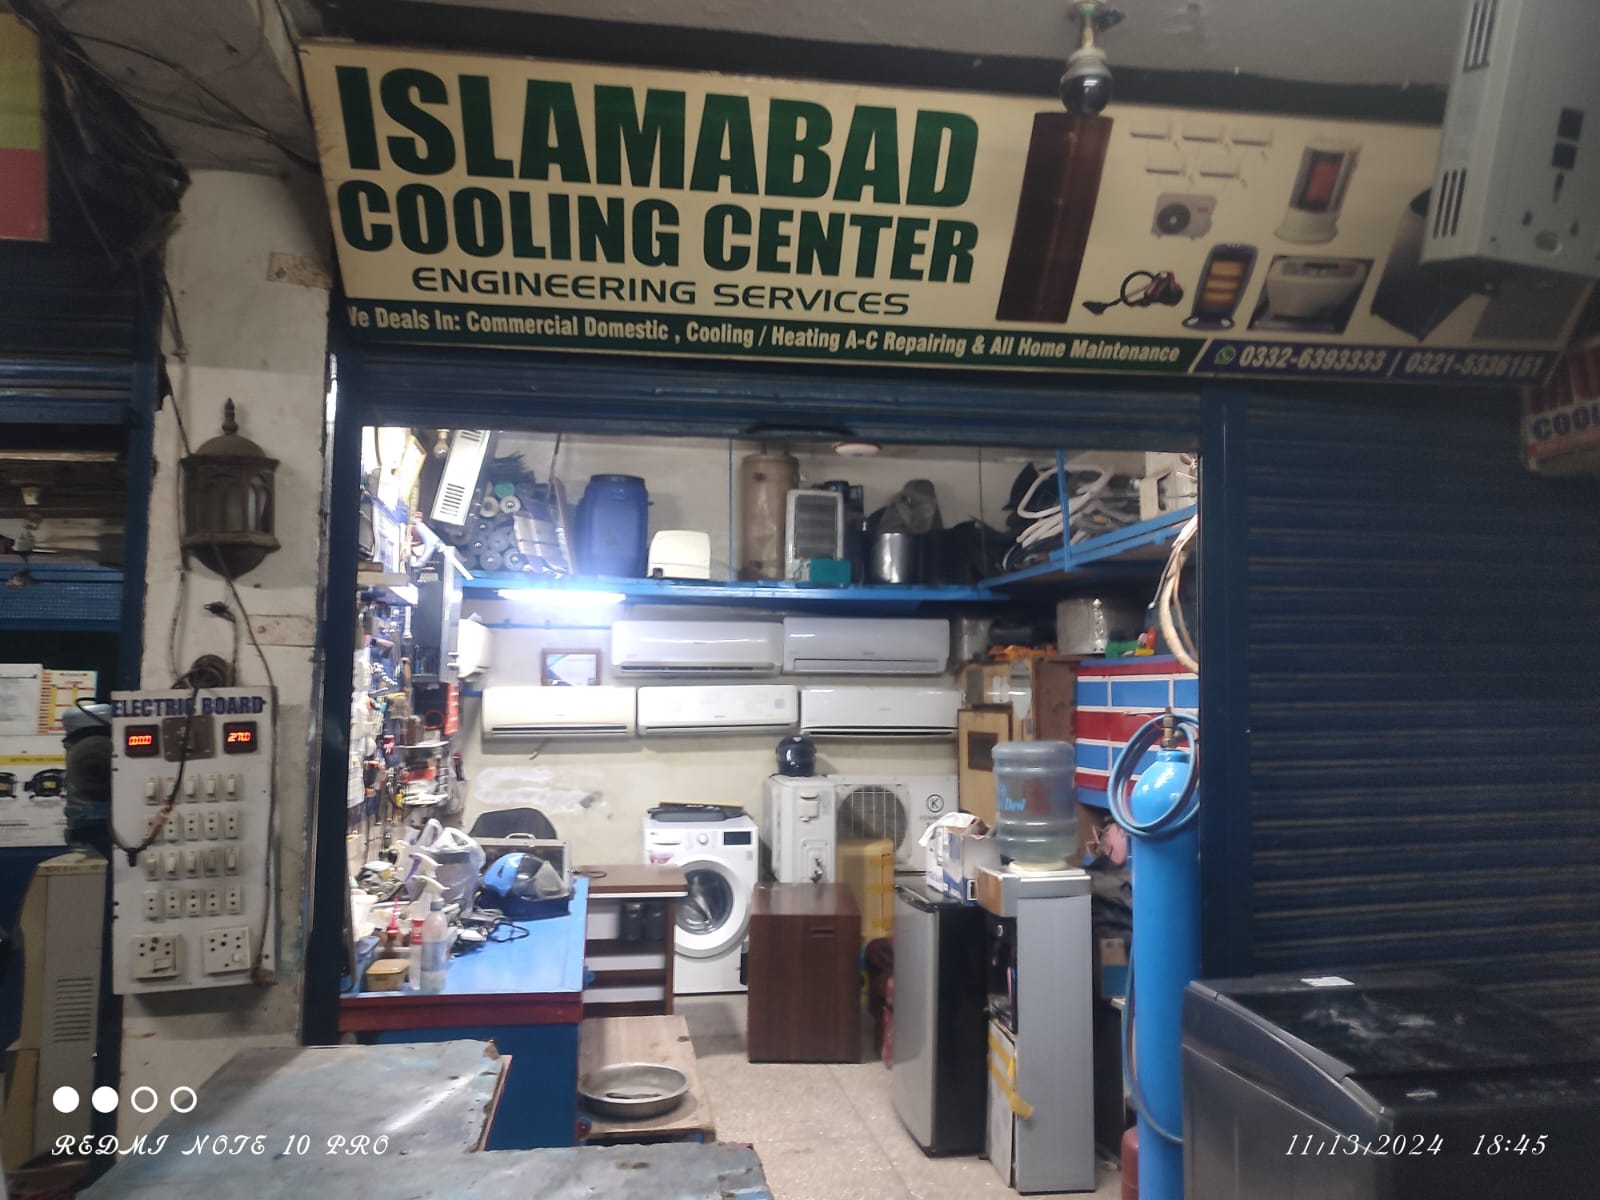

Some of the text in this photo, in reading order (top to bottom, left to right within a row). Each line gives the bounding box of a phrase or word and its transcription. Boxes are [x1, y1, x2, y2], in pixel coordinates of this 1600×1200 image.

[335, 65, 979, 208] ISLAMABAD
[337, 179, 979, 284] COOLING CENTER
[412, 267, 910, 316] ENGINEERING SERVICES
[375, 306, 430, 331] Deals
[434, 309, 461, 331] In:
[466, 310, 578, 337] Commercial
[584, 315, 669, 341] Domestic
[686, 320, 754, 348] Cooling
[771, 325, 841, 352] Heating
[845, 329, 878, 350] A-C
[883, 331, 967, 358] Repairing
[971, 335, 984, 355] &
[990, 335, 1015, 357] All
[1017, 336, 1066, 359] Home
[1070, 339, 1180, 363] Maintenance
[1240, 345, 1387, 372] 0332-6393333
[112, 696, 264, 718] ELECTRIC BOARD
